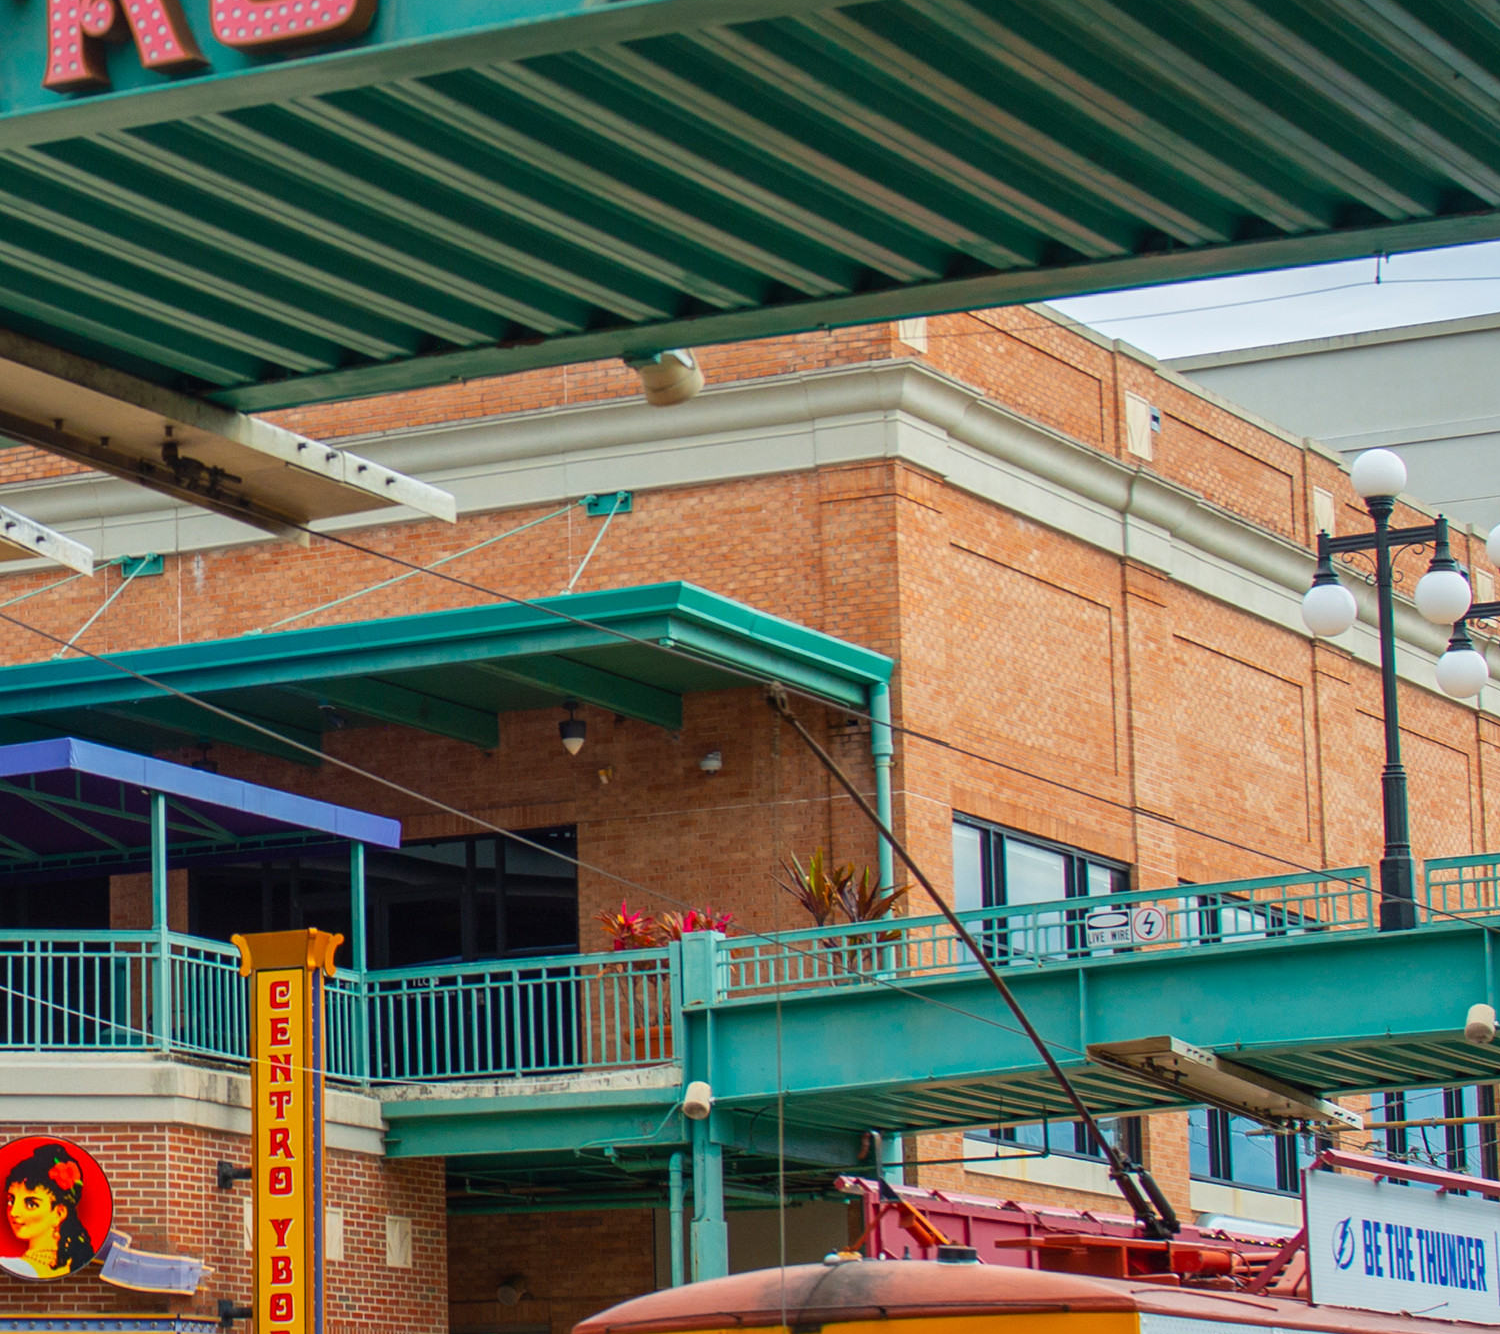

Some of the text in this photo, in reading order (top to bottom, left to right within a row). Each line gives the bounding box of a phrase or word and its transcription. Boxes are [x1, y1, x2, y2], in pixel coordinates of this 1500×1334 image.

[1087, 929, 1130, 945] LIVE WIRE
[268, 979, 295, 1196] CENTRO
[1362, 1219, 1488, 1292] BE THE THUNDER
